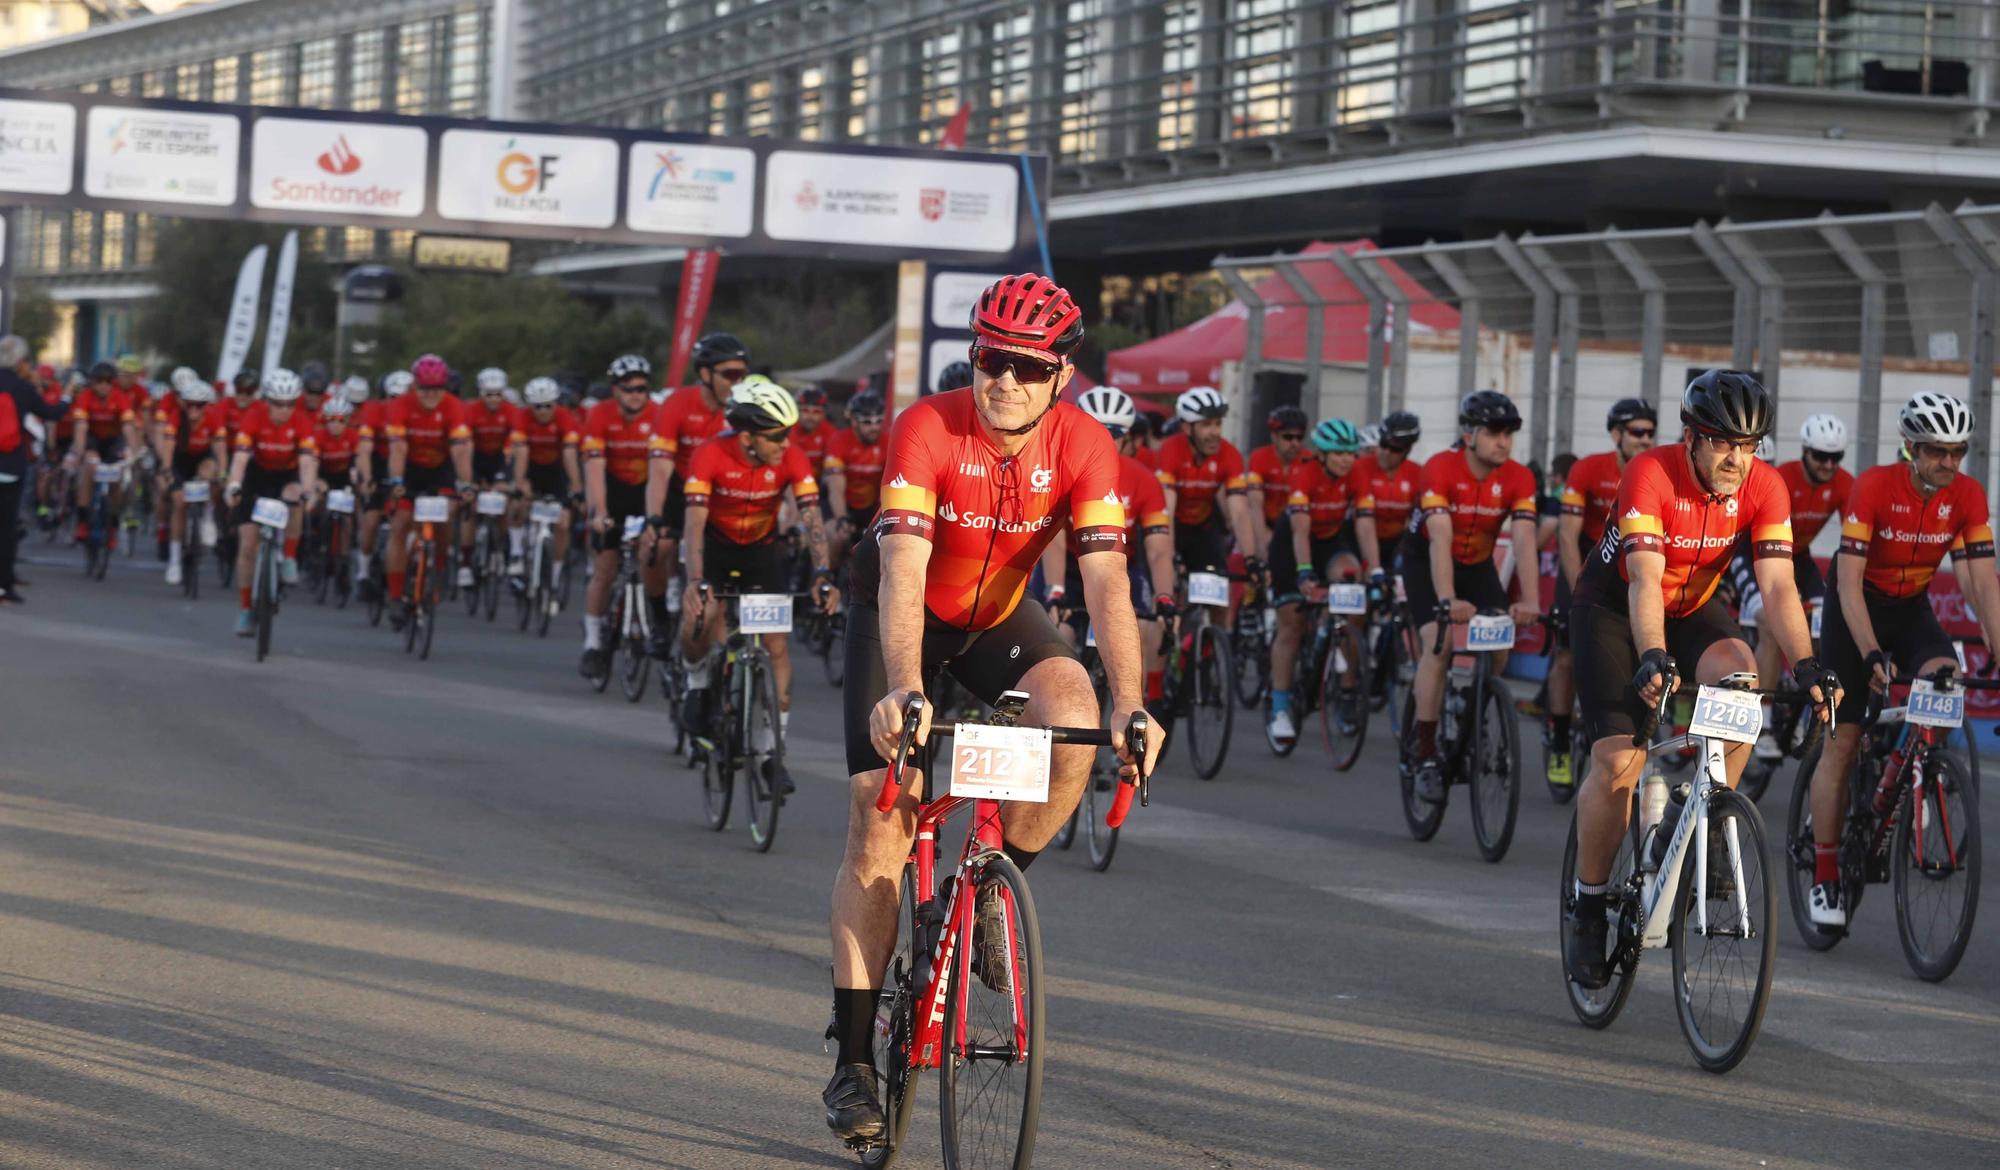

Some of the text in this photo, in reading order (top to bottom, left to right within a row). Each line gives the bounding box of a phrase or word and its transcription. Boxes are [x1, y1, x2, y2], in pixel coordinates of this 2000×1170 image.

[497, 152, 559, 194] GF
[272, 177, 402, 207] Santander
[1030, 469, 1053, 487] GF
[960, 511, 1053, 533] Santande
[1895, 530, 1953, 544] Santande
[745, 606, 779, 621] 1221
[1472, 626, 1506, 641] 1627
[1702, 700, 1749, 726] 1216
[1914, 694, 1953, 714] 1148
